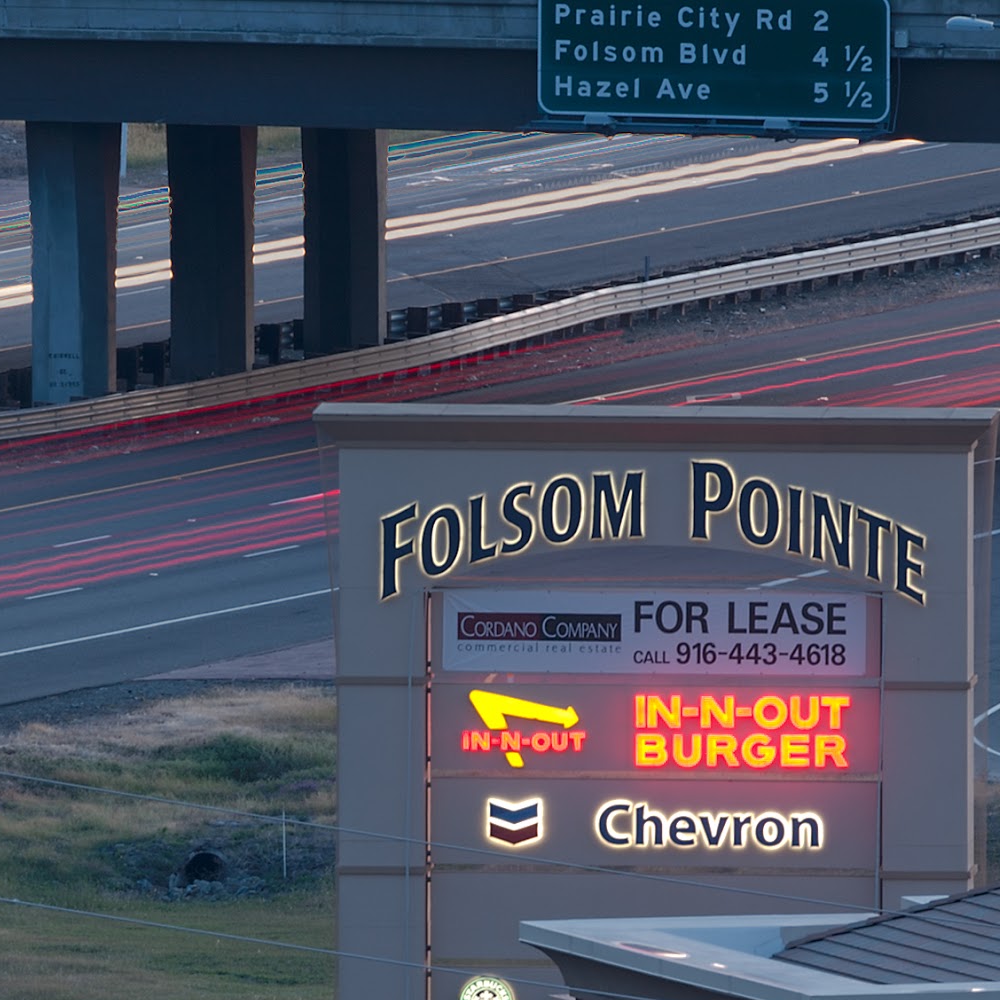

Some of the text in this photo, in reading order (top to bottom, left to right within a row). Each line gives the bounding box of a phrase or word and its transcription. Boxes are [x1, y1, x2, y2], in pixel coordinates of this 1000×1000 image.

[555, 4, 829, 38] Prairie City Rd 2
[555, 40, 664, 63] Folsom
[679, 43, 747, 66] Blvd
[812, 46, 829, 67] 4
[555, 76, 640, 98] Hazel
[656, 78, 711, 100] Ave
[813, 82, 829, 103] 5
[380, 459, 926, 605] FOLSOM POINTE
[633, 601, 847, 636] FOR LEASE
[456, 642, 622, 654] commercial real estate
[633, 642, 847, 667] CALL 916-443-4618
[635, 695, 850, 729] IN-N-OUT
[462, 730, 586, 752] IN-N-OUT
[635, 734, 849, 768] BURGER
[599, 801, 822, 847] Chevron
